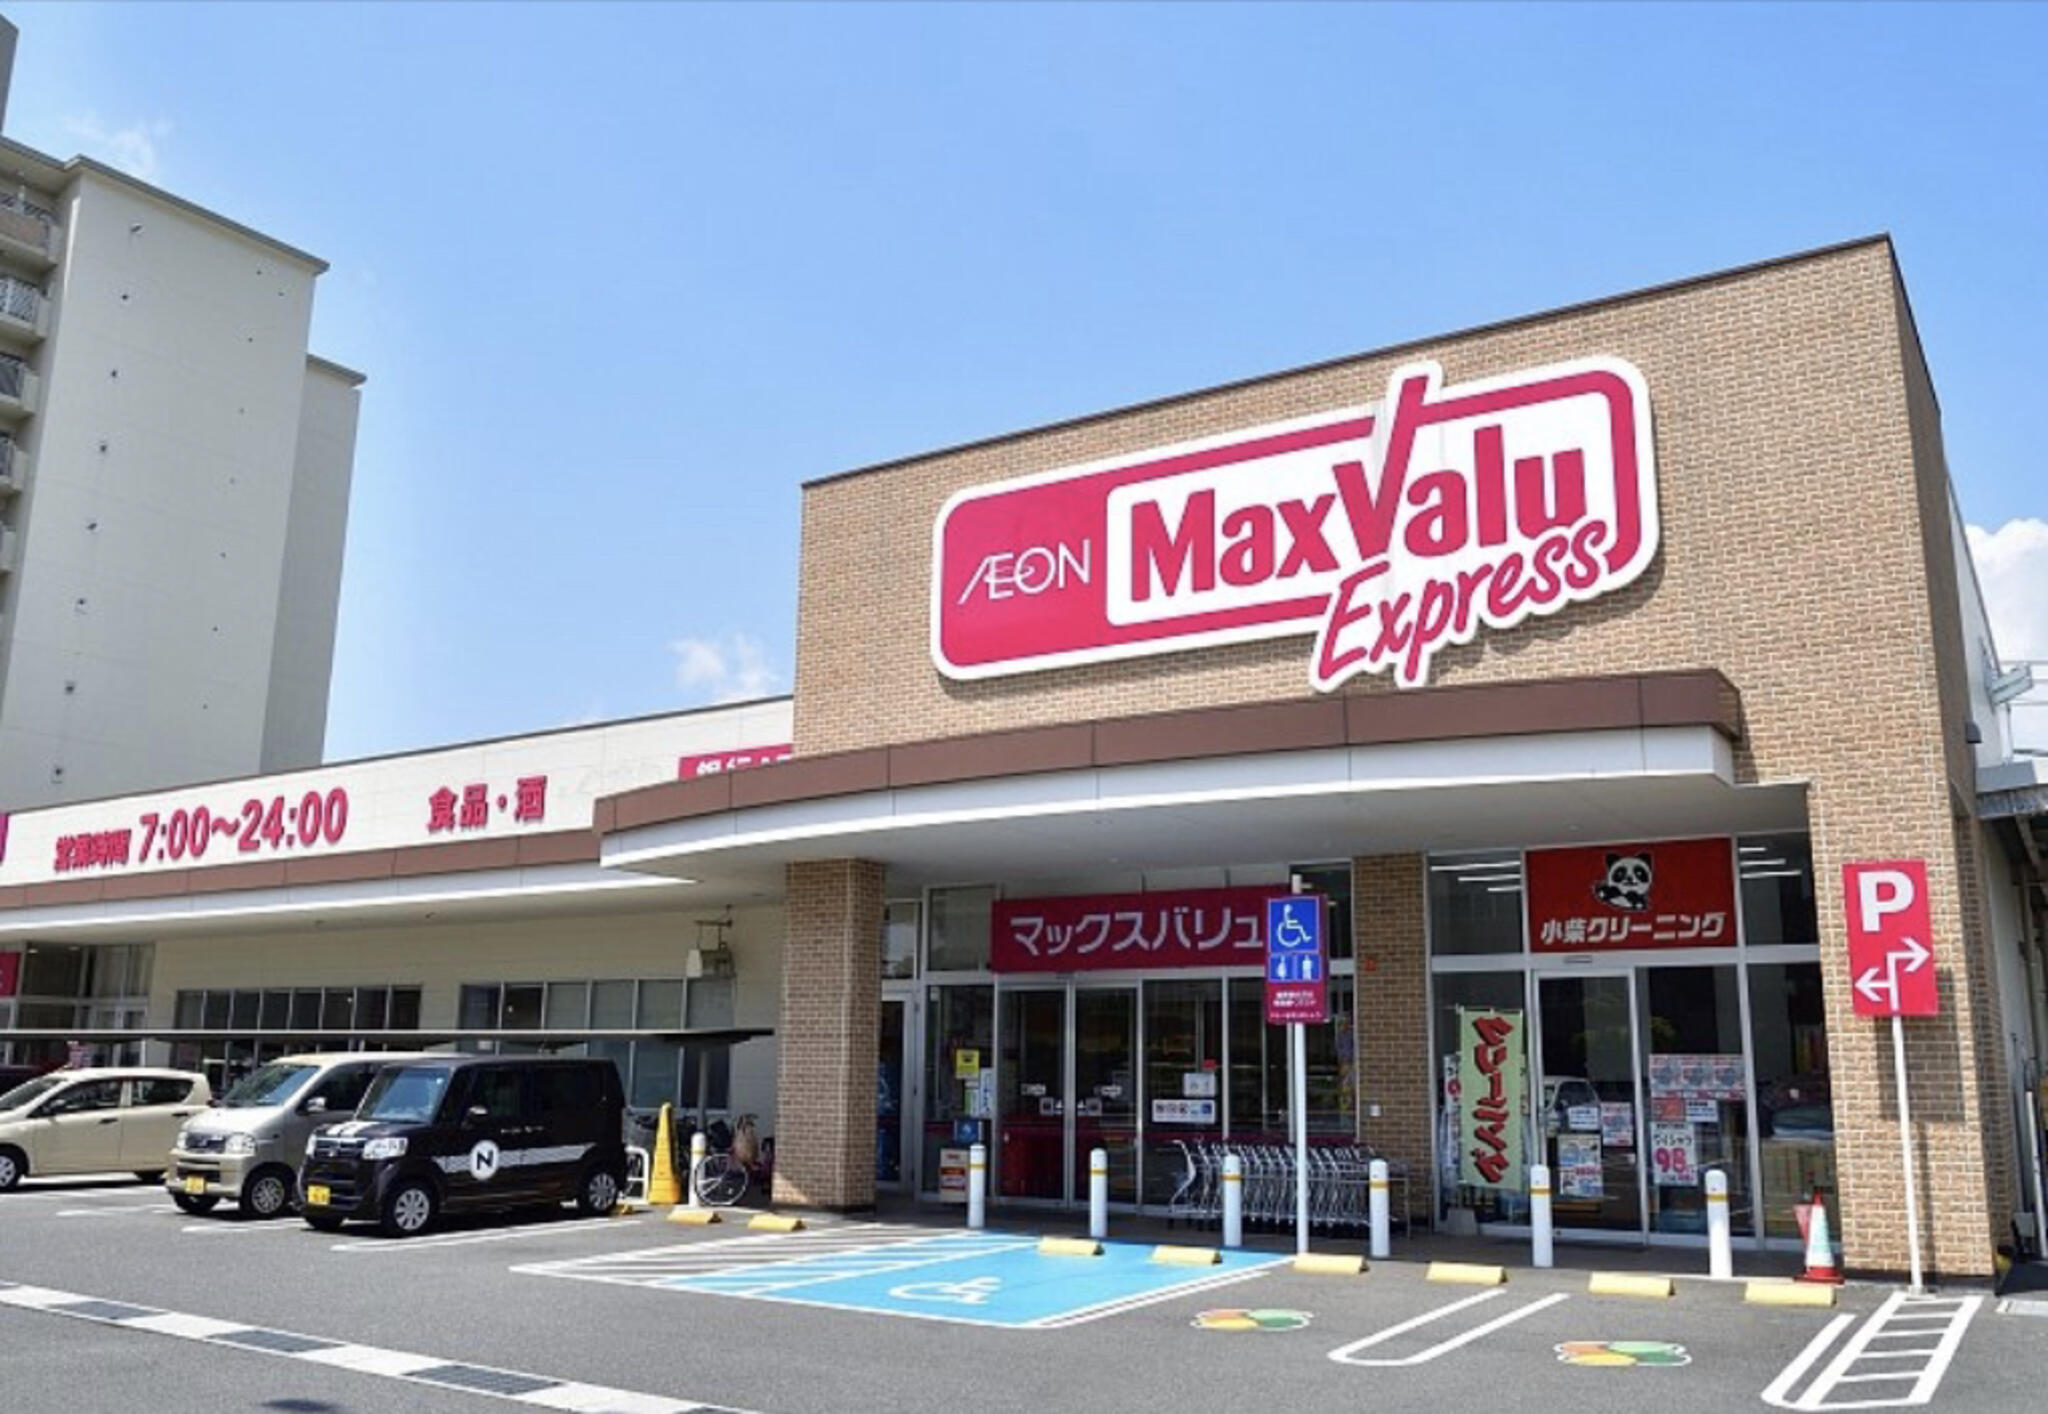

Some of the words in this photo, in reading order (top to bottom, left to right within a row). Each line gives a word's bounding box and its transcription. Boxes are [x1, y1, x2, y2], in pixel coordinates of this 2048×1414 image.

[1130, 376, 1587, 602] MaxValu
[1317, 520, 1607, 682] Express
[1857, 870, 1914, 931] P
[1010, 906, 1264, 956] マックスバリュ
[476, 1151, 494, 1170] N
[1656, 1147, 1687, 1173] 98
